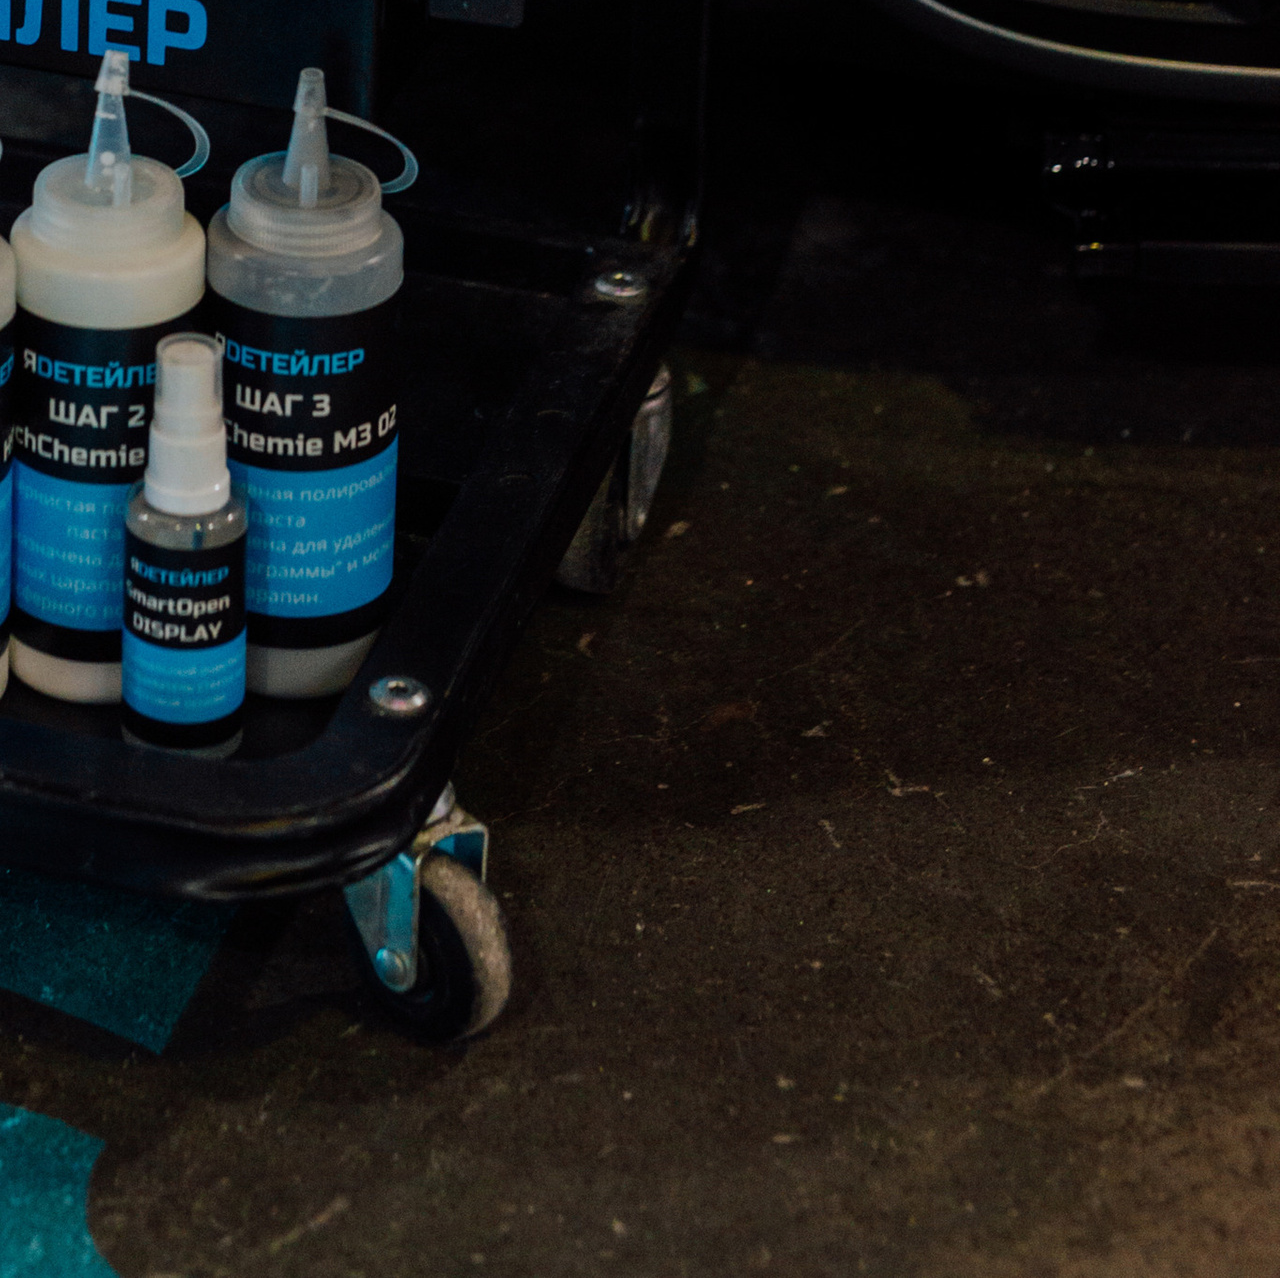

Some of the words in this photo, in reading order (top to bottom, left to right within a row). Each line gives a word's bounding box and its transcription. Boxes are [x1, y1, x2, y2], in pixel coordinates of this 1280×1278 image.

[49, 398, 119, 429] ШАГ
[128, 404, 146, 429] 2
[236, 383, 304, 417] ШАГ
[311, 395, 331, 417] 3
[333, 422, 372, 454] M3
[377, 403, 397, 438] 02
[292, 539, 328, 556] для
[126, 578, 230, 619] SmartOpen
[133, 611, 223, 643] DISPLAY
